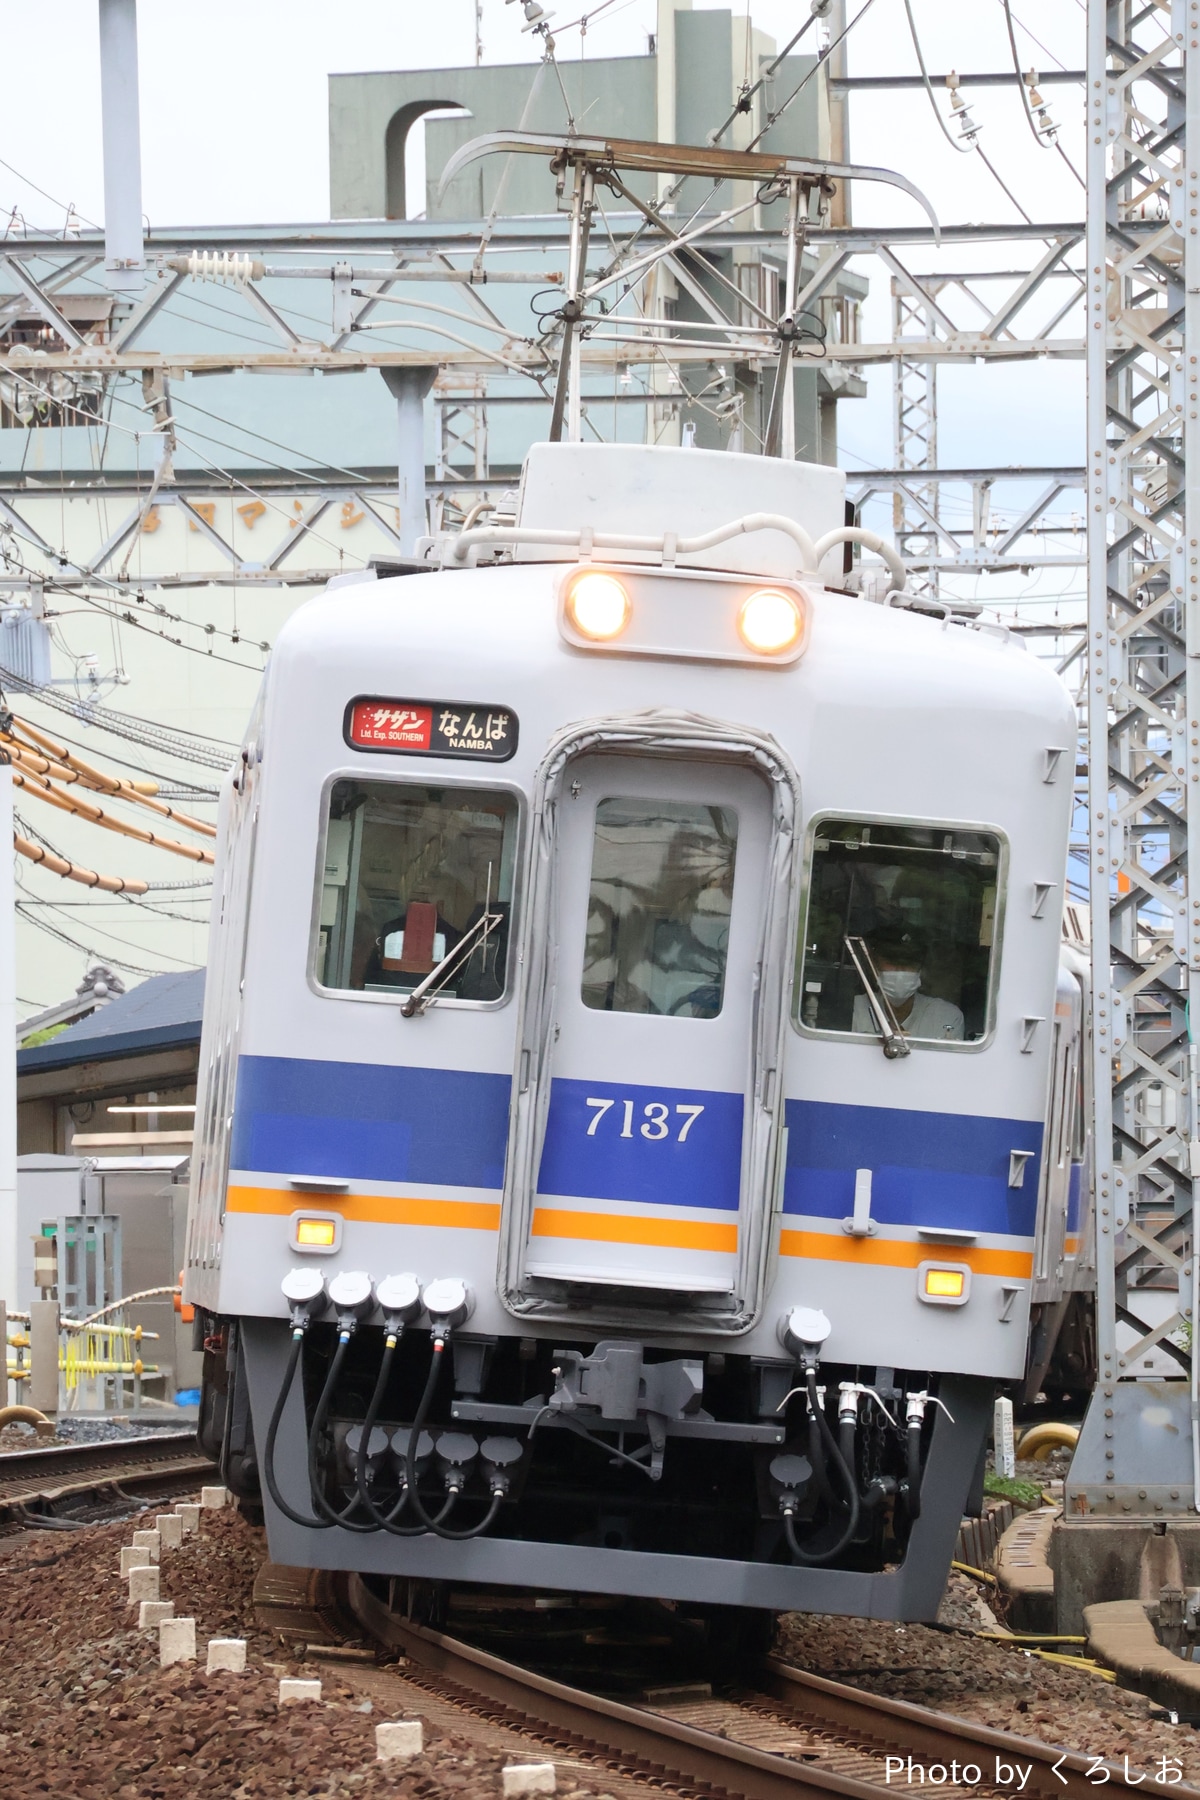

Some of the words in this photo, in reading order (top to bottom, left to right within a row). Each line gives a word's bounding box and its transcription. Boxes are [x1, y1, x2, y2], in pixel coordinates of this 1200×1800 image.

[372, 708, 425, 730] サザン
[438, 710, 509, 740] なんば
[360, 729, 373, 738] Ltd.
[373, 731, 387, 741] Exp.
[388, 731, 424, 742] SOUTHERN
[449, 738, 493, 750] NAMBA
[586, 1097, 705, 1142] 7137
